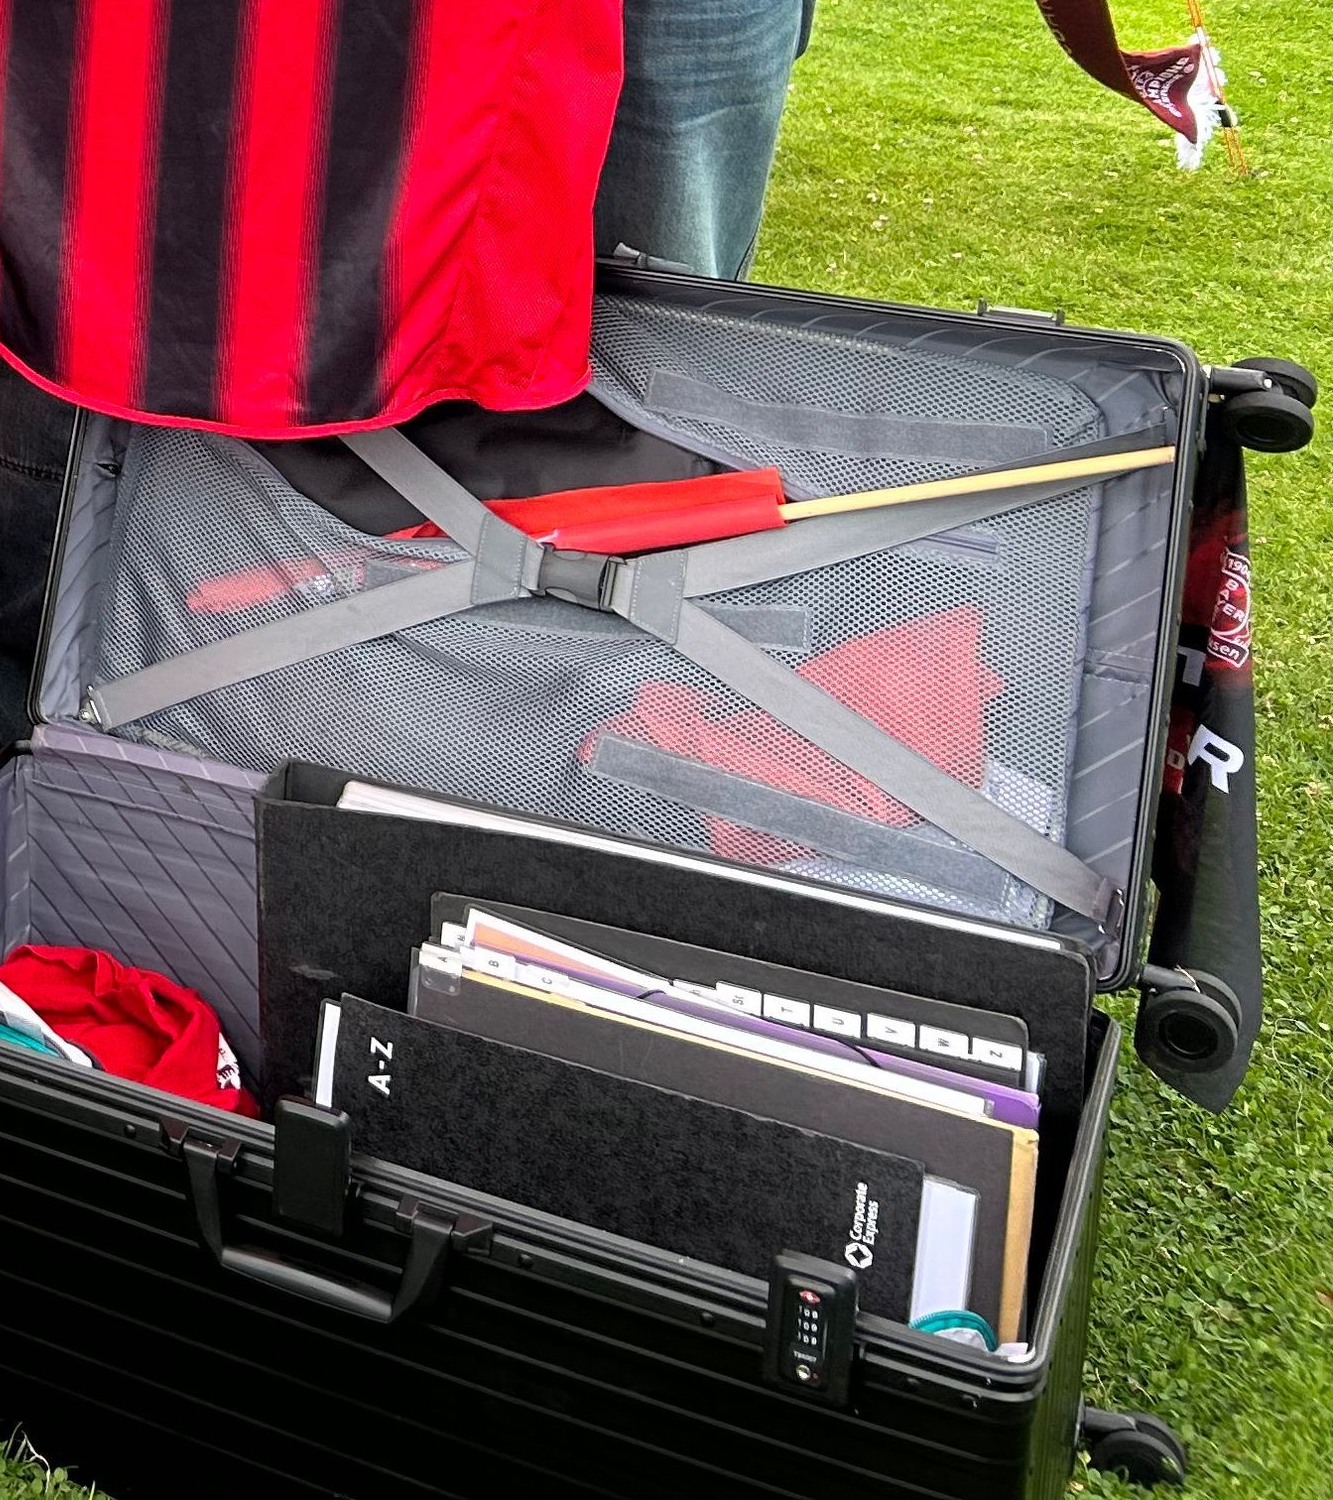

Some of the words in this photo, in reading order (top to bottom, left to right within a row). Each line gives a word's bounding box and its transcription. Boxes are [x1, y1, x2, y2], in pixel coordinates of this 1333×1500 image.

[487, 958, 501, 968] B
[540, 975, 554, 986] C
[368, 1037, 395, 1096] A-Z
[989, 1050, 1003, 1059] Z
[849, 1181, 869, 1241] Corporate
[862, 1200, 879, 1245] Express
